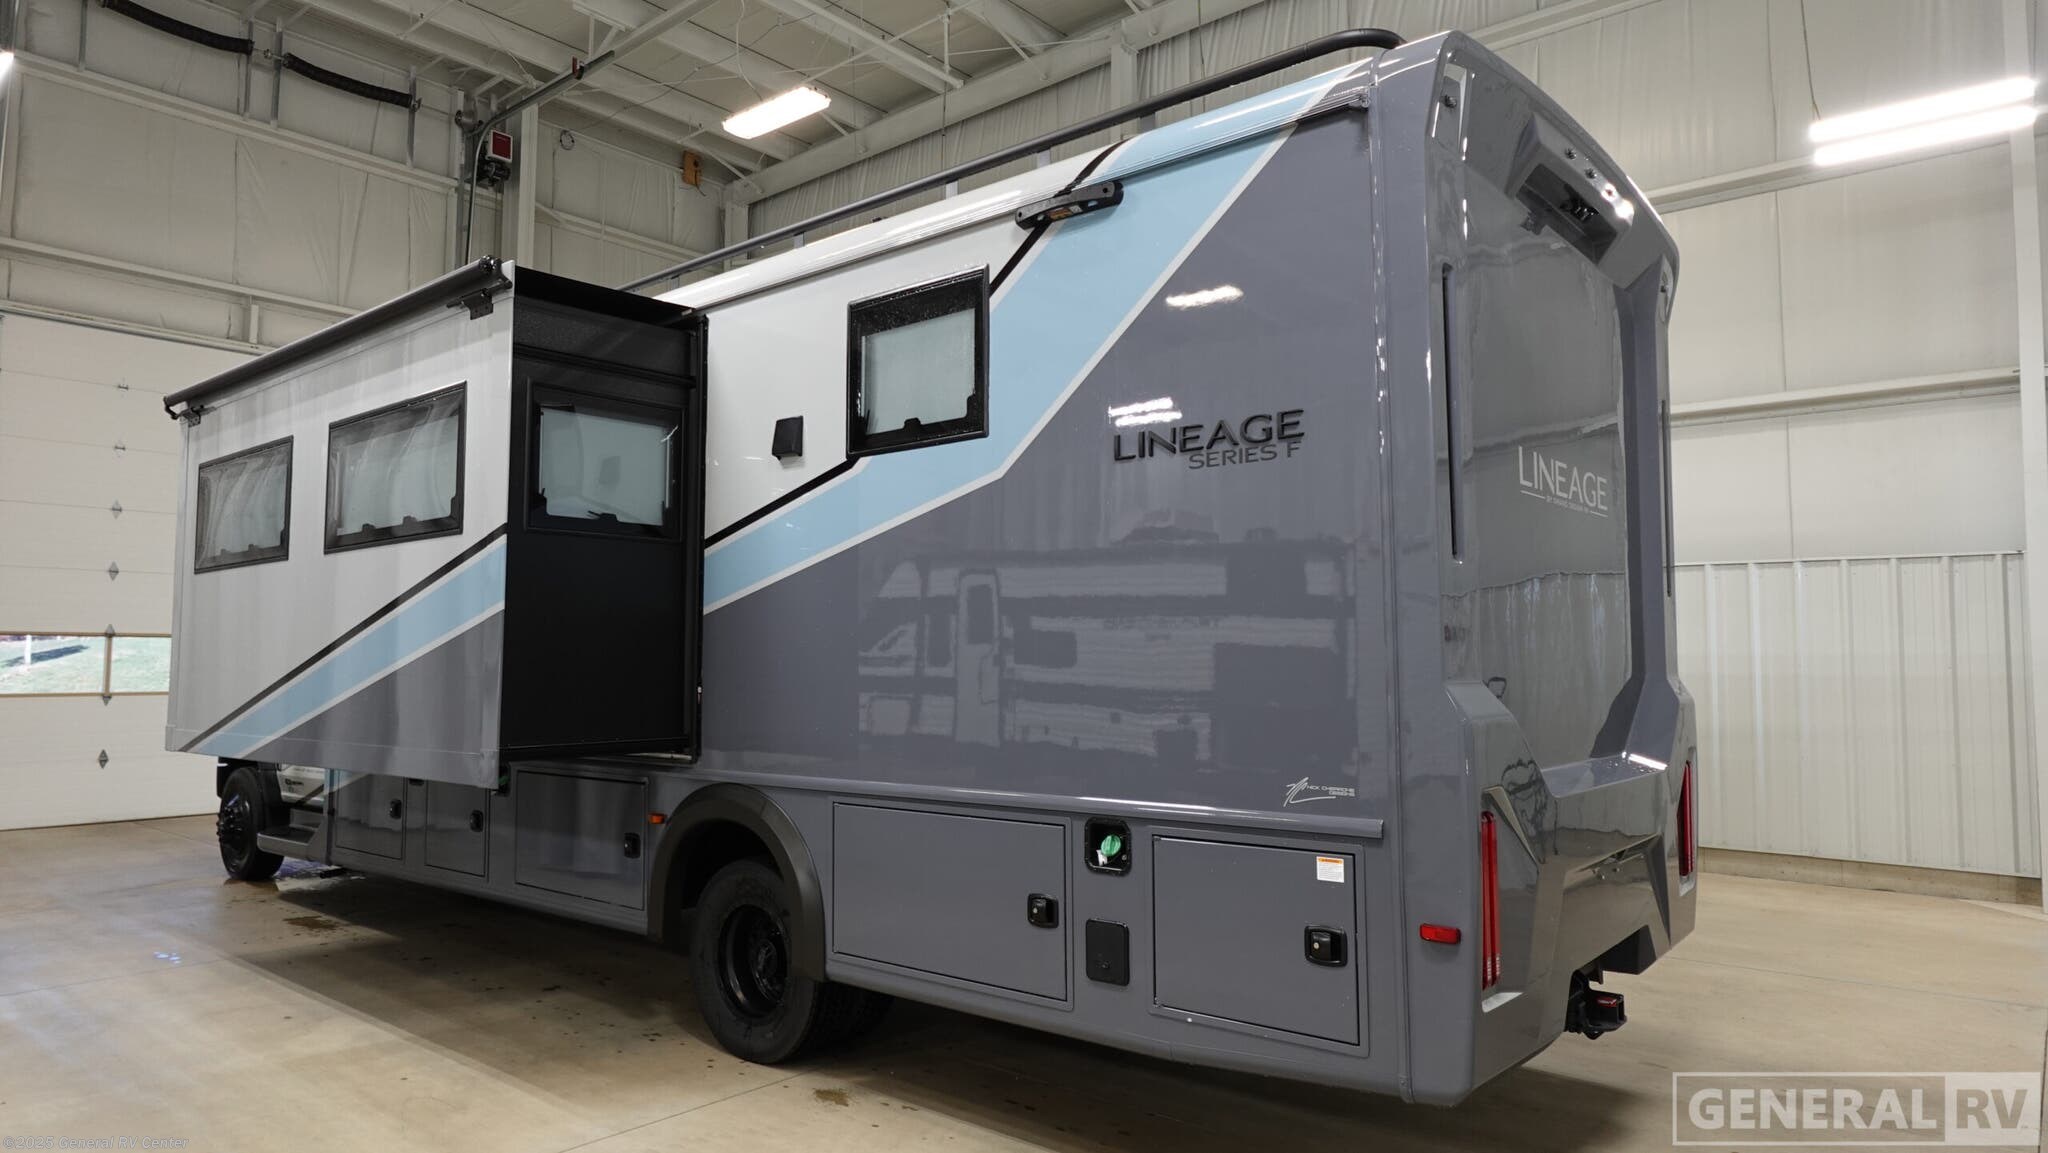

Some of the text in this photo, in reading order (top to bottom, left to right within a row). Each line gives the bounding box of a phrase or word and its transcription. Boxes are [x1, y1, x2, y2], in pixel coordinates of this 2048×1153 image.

[1113, 408, 1306, 461] LINEAGE
[1188, 441, 1301, 470] SERIES F
[1518, 445, 1609, 511] LINEAGE
